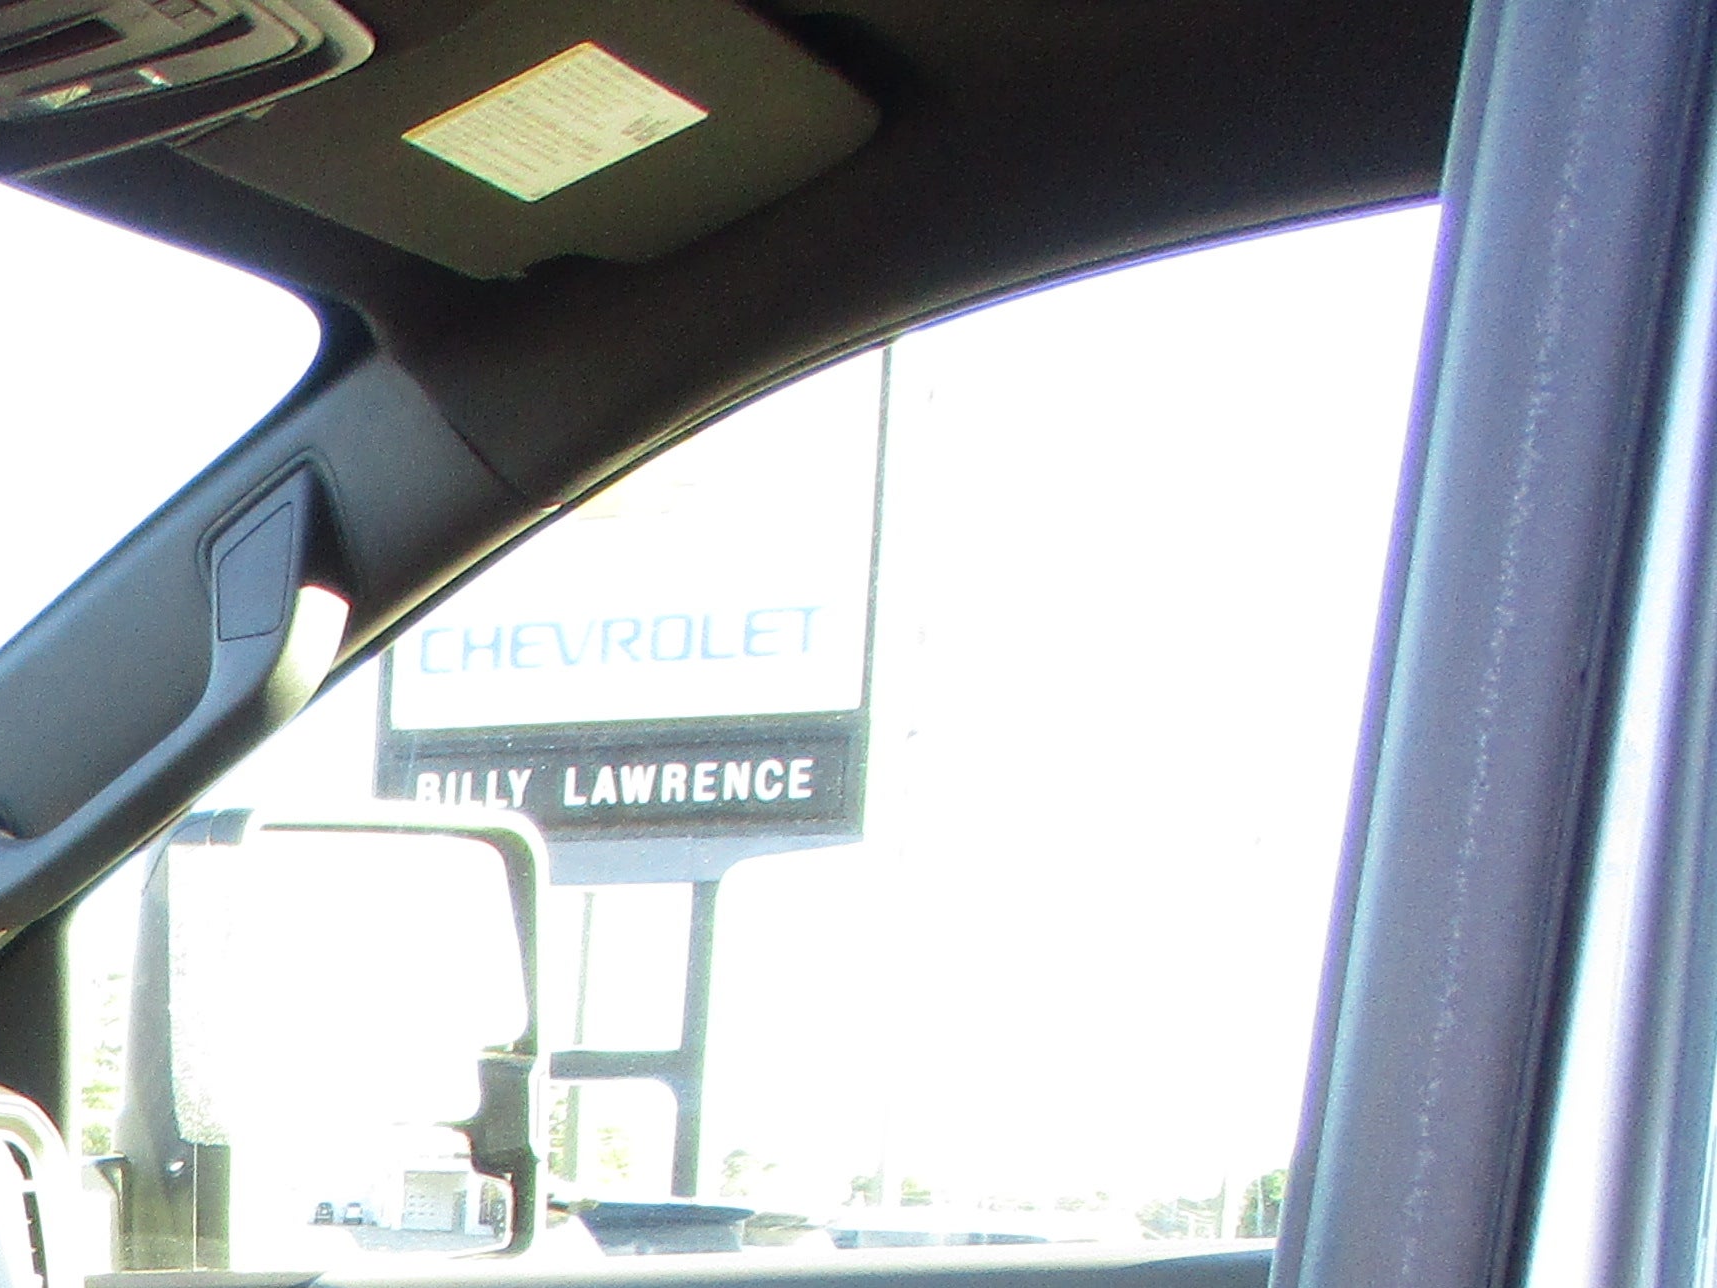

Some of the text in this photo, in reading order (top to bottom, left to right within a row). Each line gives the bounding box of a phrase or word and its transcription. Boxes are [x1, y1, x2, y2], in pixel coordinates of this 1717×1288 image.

[420, 605, 822, 674] CHEVROLET
[415, 758, 816, 809] BILLY LAWRENCE
